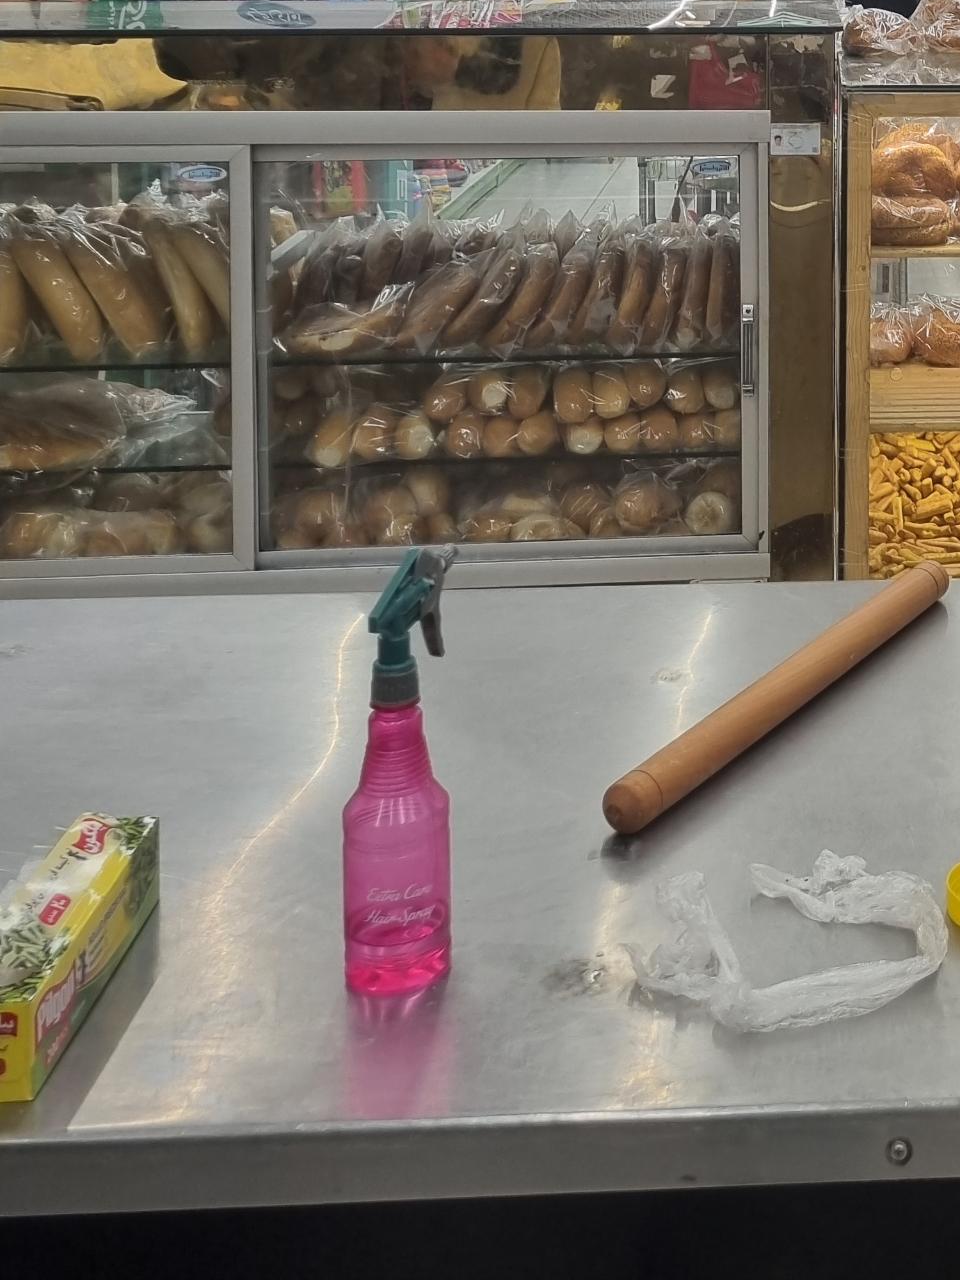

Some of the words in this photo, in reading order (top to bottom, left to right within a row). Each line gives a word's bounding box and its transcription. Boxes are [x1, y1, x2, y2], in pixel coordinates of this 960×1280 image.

[367, 887, 401, 902] Extra
[404, 883, 433, 900] Care
[366, 909, 397, 924] Hair
[402, 904, 436, 927] Spray
